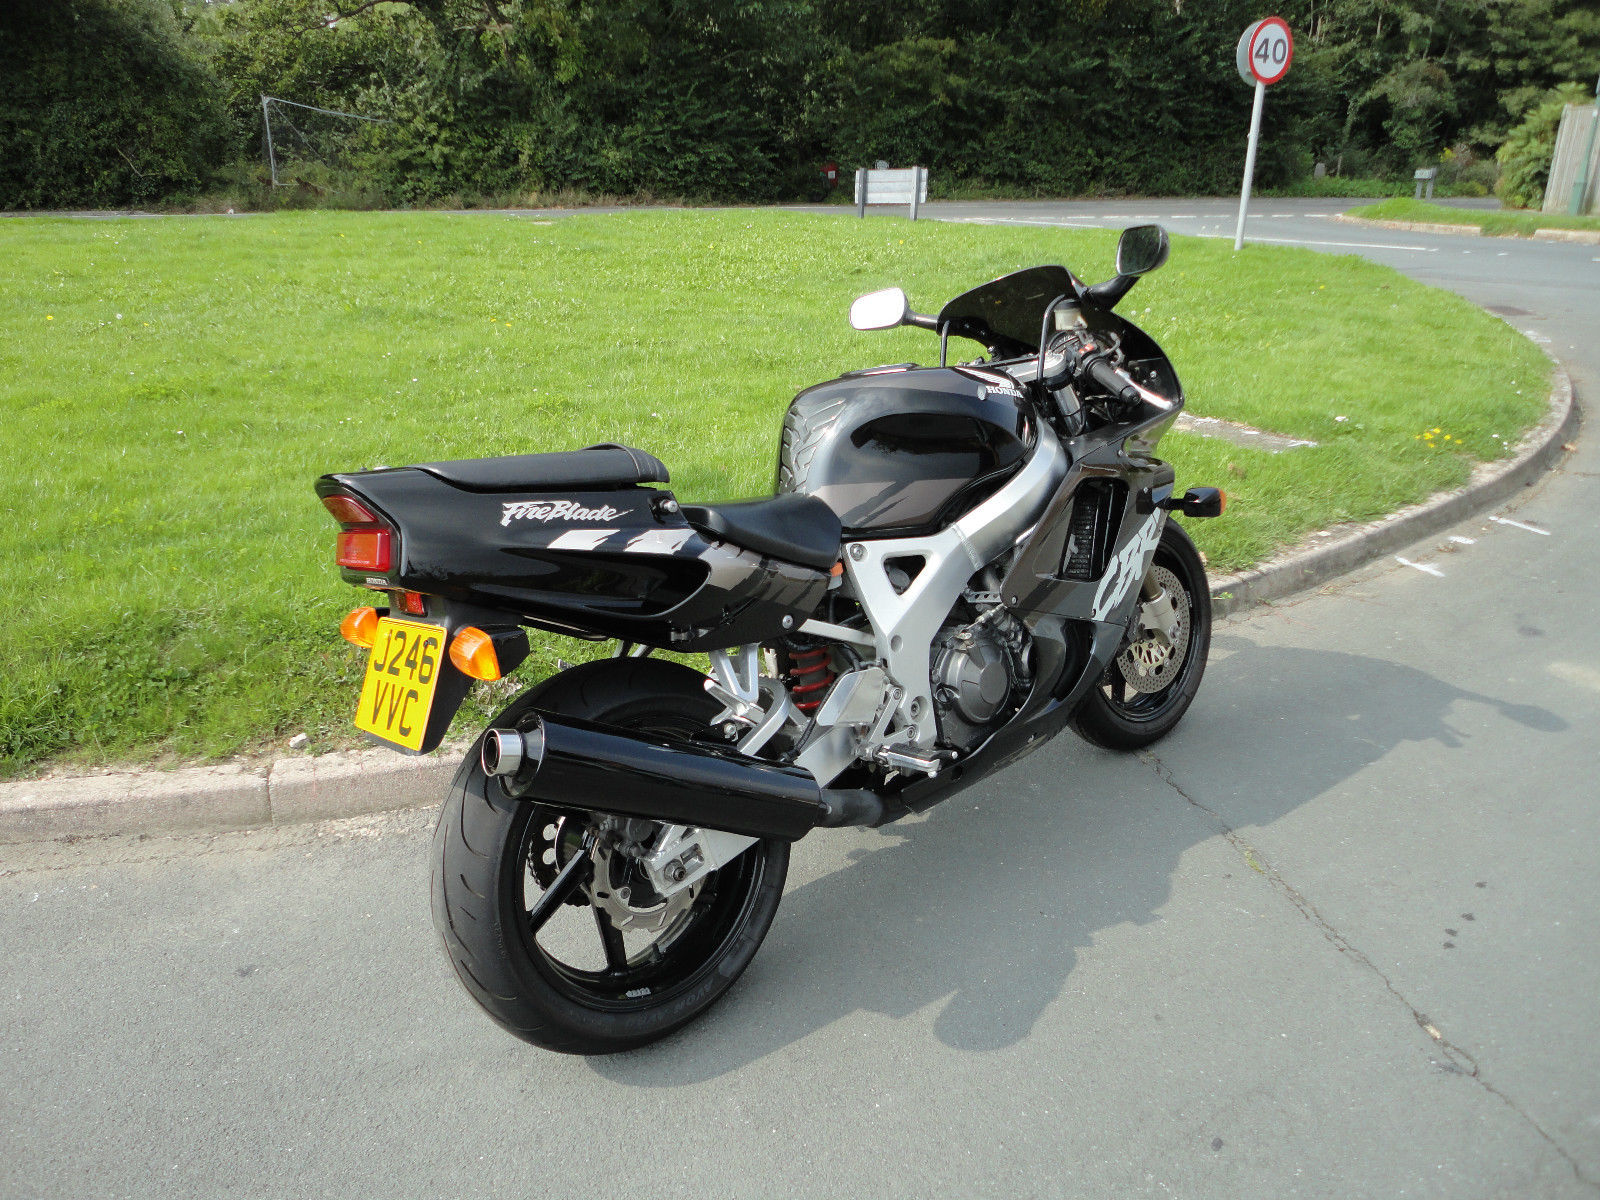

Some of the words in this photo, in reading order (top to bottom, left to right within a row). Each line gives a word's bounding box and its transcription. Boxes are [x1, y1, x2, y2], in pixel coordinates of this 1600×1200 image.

[1254, 38, 1287, 64] 40
[985, 385, 1024, 399] HONDA
[500, 500, 634, 526] FireBlade
[1092, 506, 1160, 621] CBR
[373, 629, 438, 684] J246
[372, 679, 419, 737] VVC
